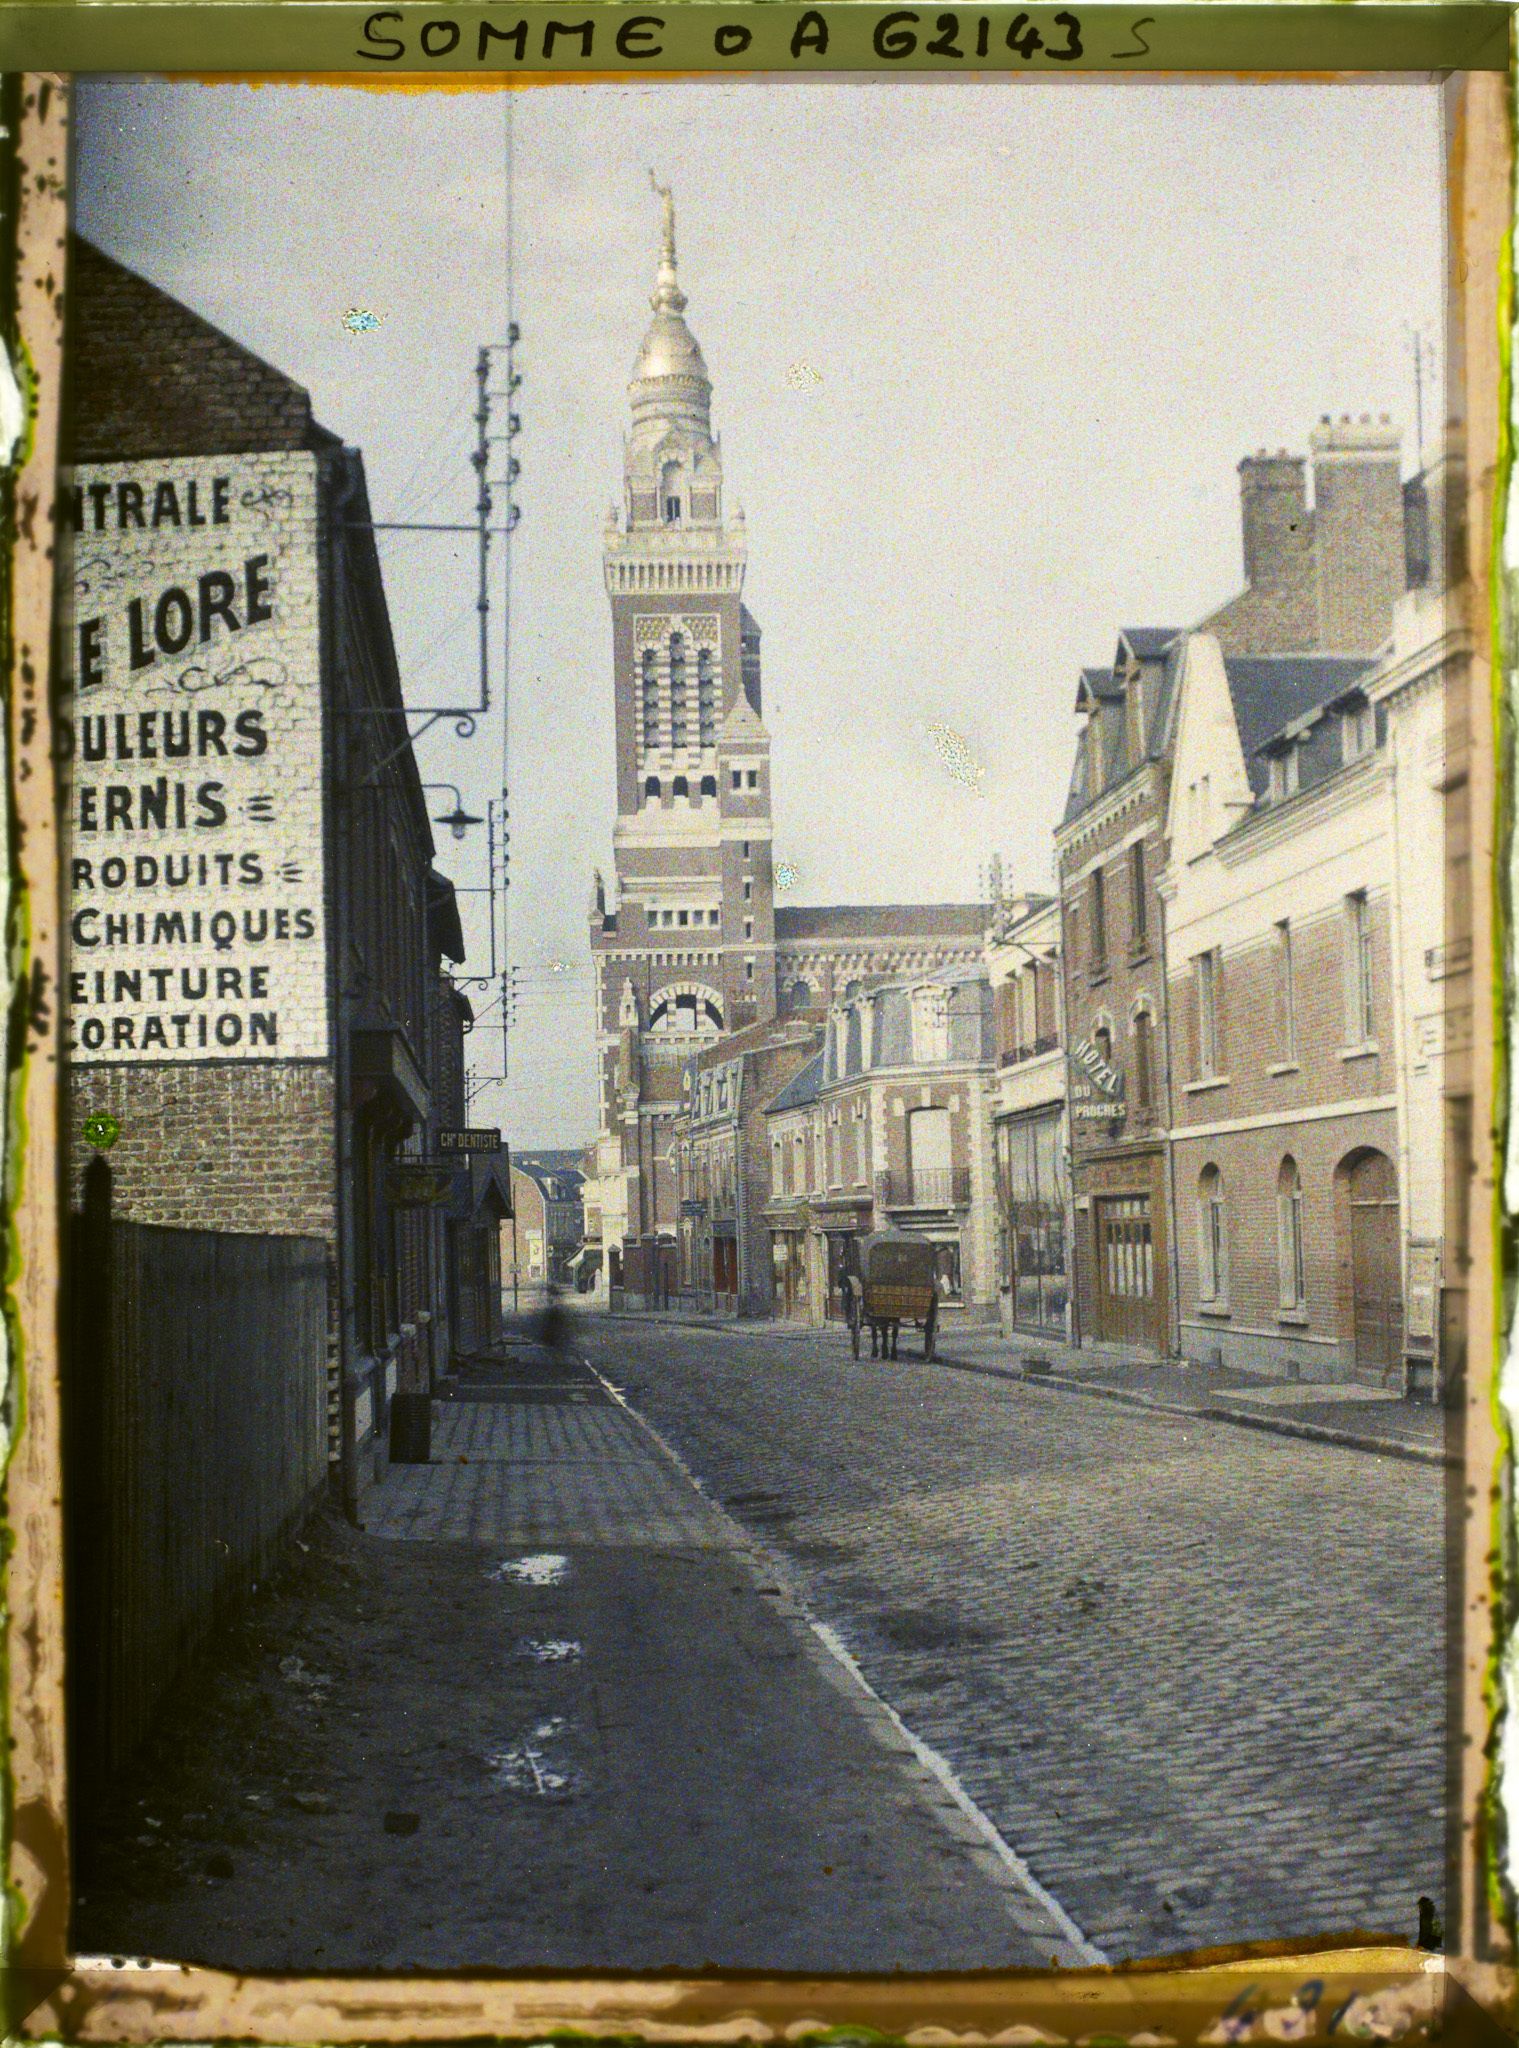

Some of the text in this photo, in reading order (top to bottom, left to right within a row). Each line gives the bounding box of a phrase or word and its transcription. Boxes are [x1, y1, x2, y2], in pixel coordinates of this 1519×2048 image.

[356, 12, 666, 61] SOMME
[790, 11, 829, 58] A
[128, 554, 272, 671] LORE
[72, 853, 263, 890] RODUITS
[72, 907, 315, 950] CHIMIQUES
[458, 1133, 498, 1148] DENTISTE
